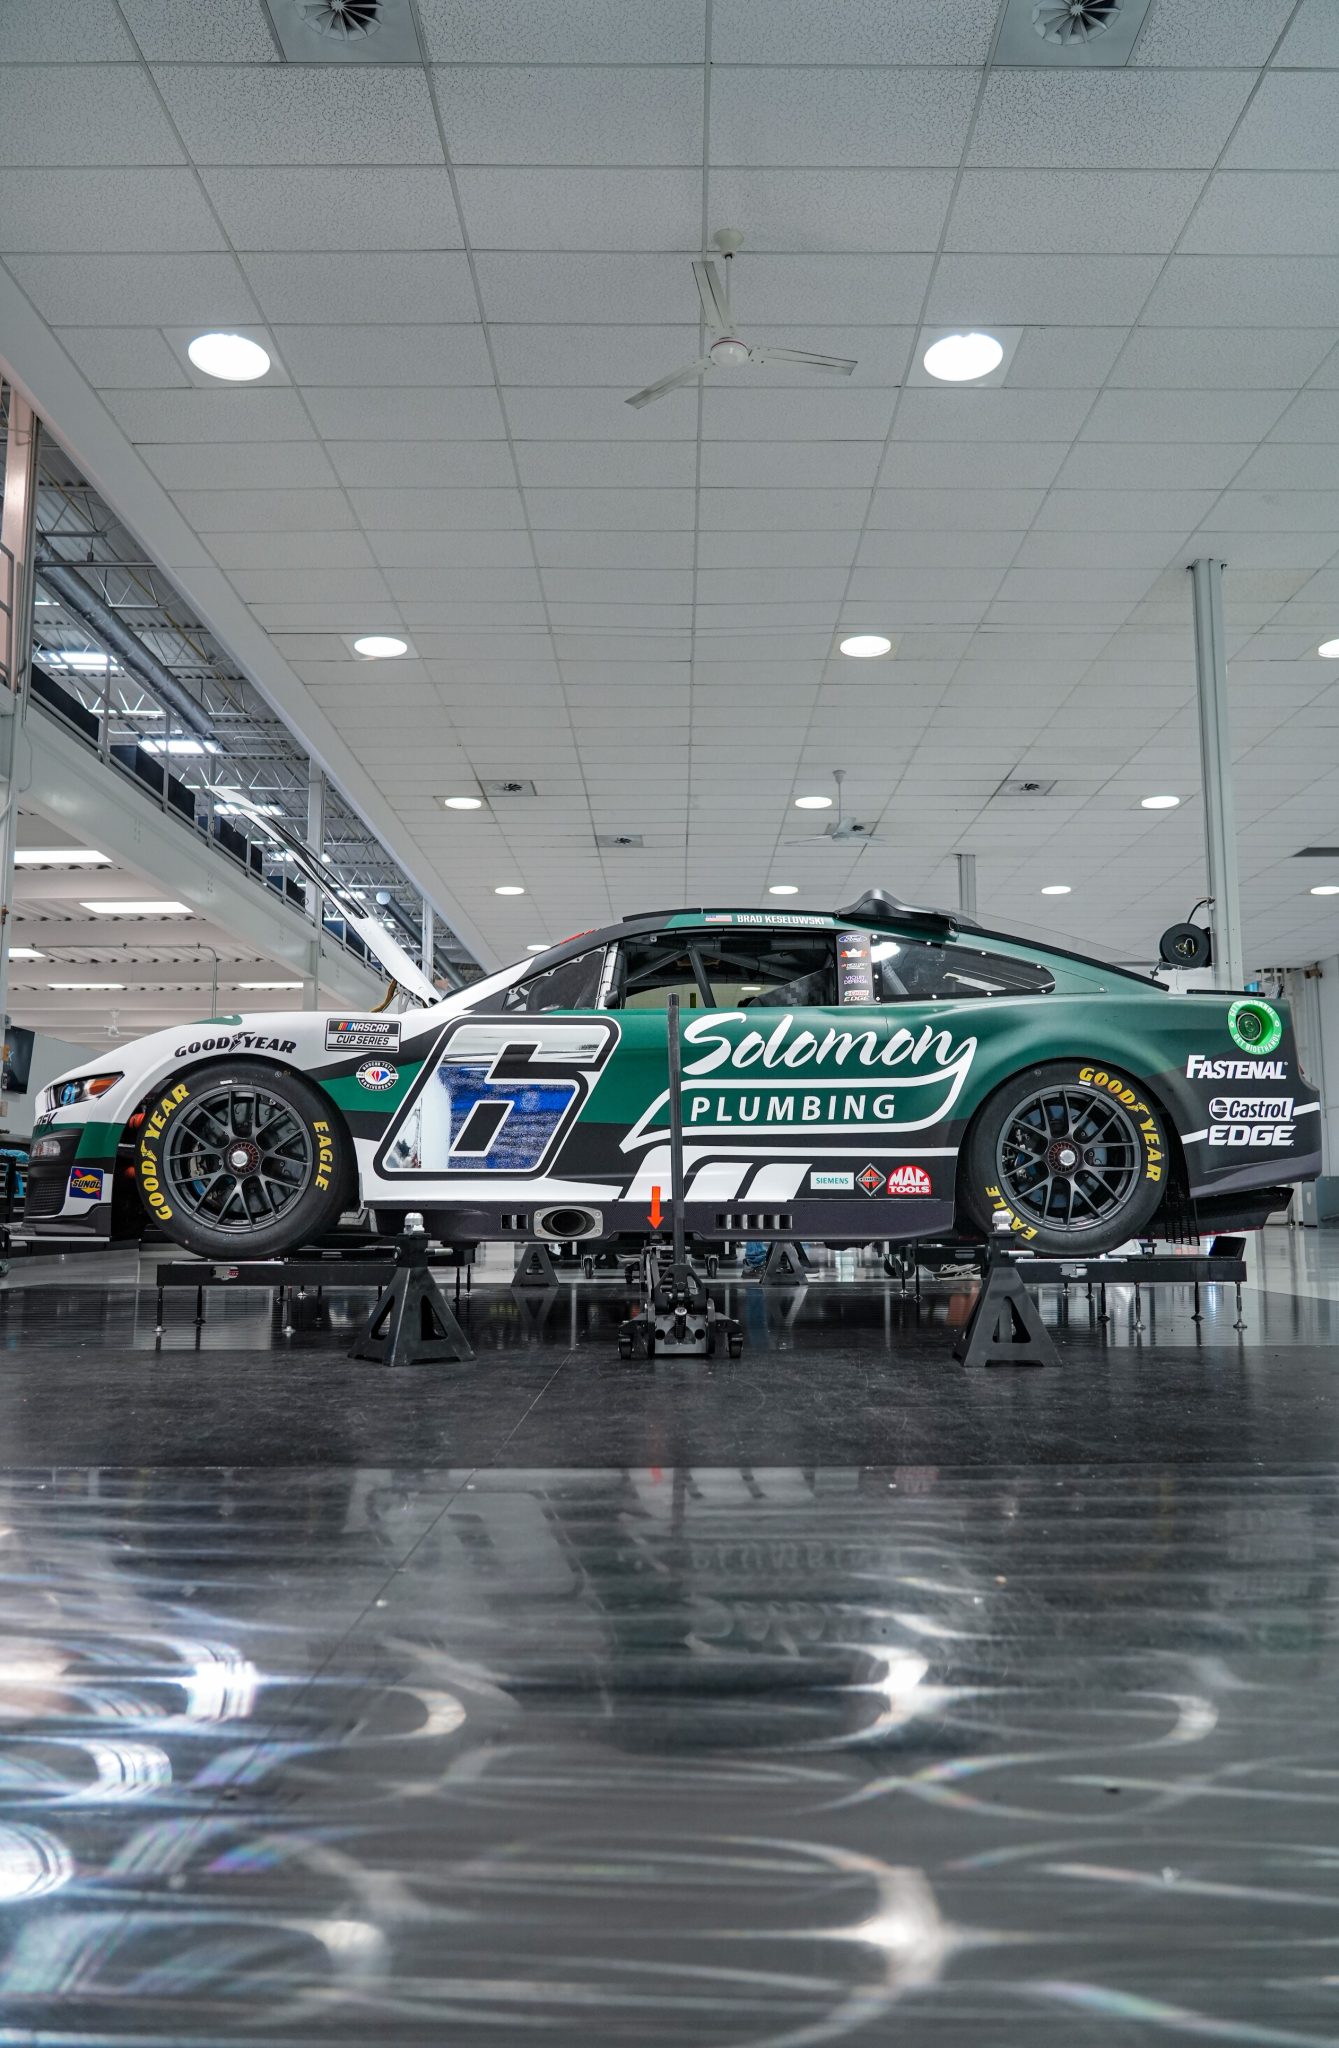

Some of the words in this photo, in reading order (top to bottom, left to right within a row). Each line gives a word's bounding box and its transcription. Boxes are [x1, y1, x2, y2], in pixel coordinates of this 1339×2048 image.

[737, 914, 762, 923] BRAD
[764, 914, 825, 925] KESELOWSKI
[350, 1022, 390, 1033] NASCAR
[336, 1034, 357, 1044] CUP
[356, 1035, 390, 1046] SERIES
[682, 1012, 976, 1075] Solomon
[374, 1015, 622, 1181] 6
[690, 1094, 895, 1122] PLUMBING
[1229, 1100, 1287, 1119] Castrol
[1208, 1124, 1297, 1146] EDGE
[313, 1120, 334, 1192] EAGLE
[816, 1177, 849, 1185] SIEMENS
[889, 1166, 930, 1185] MAC
[888, 1185, 930, 1193] TOOLS
